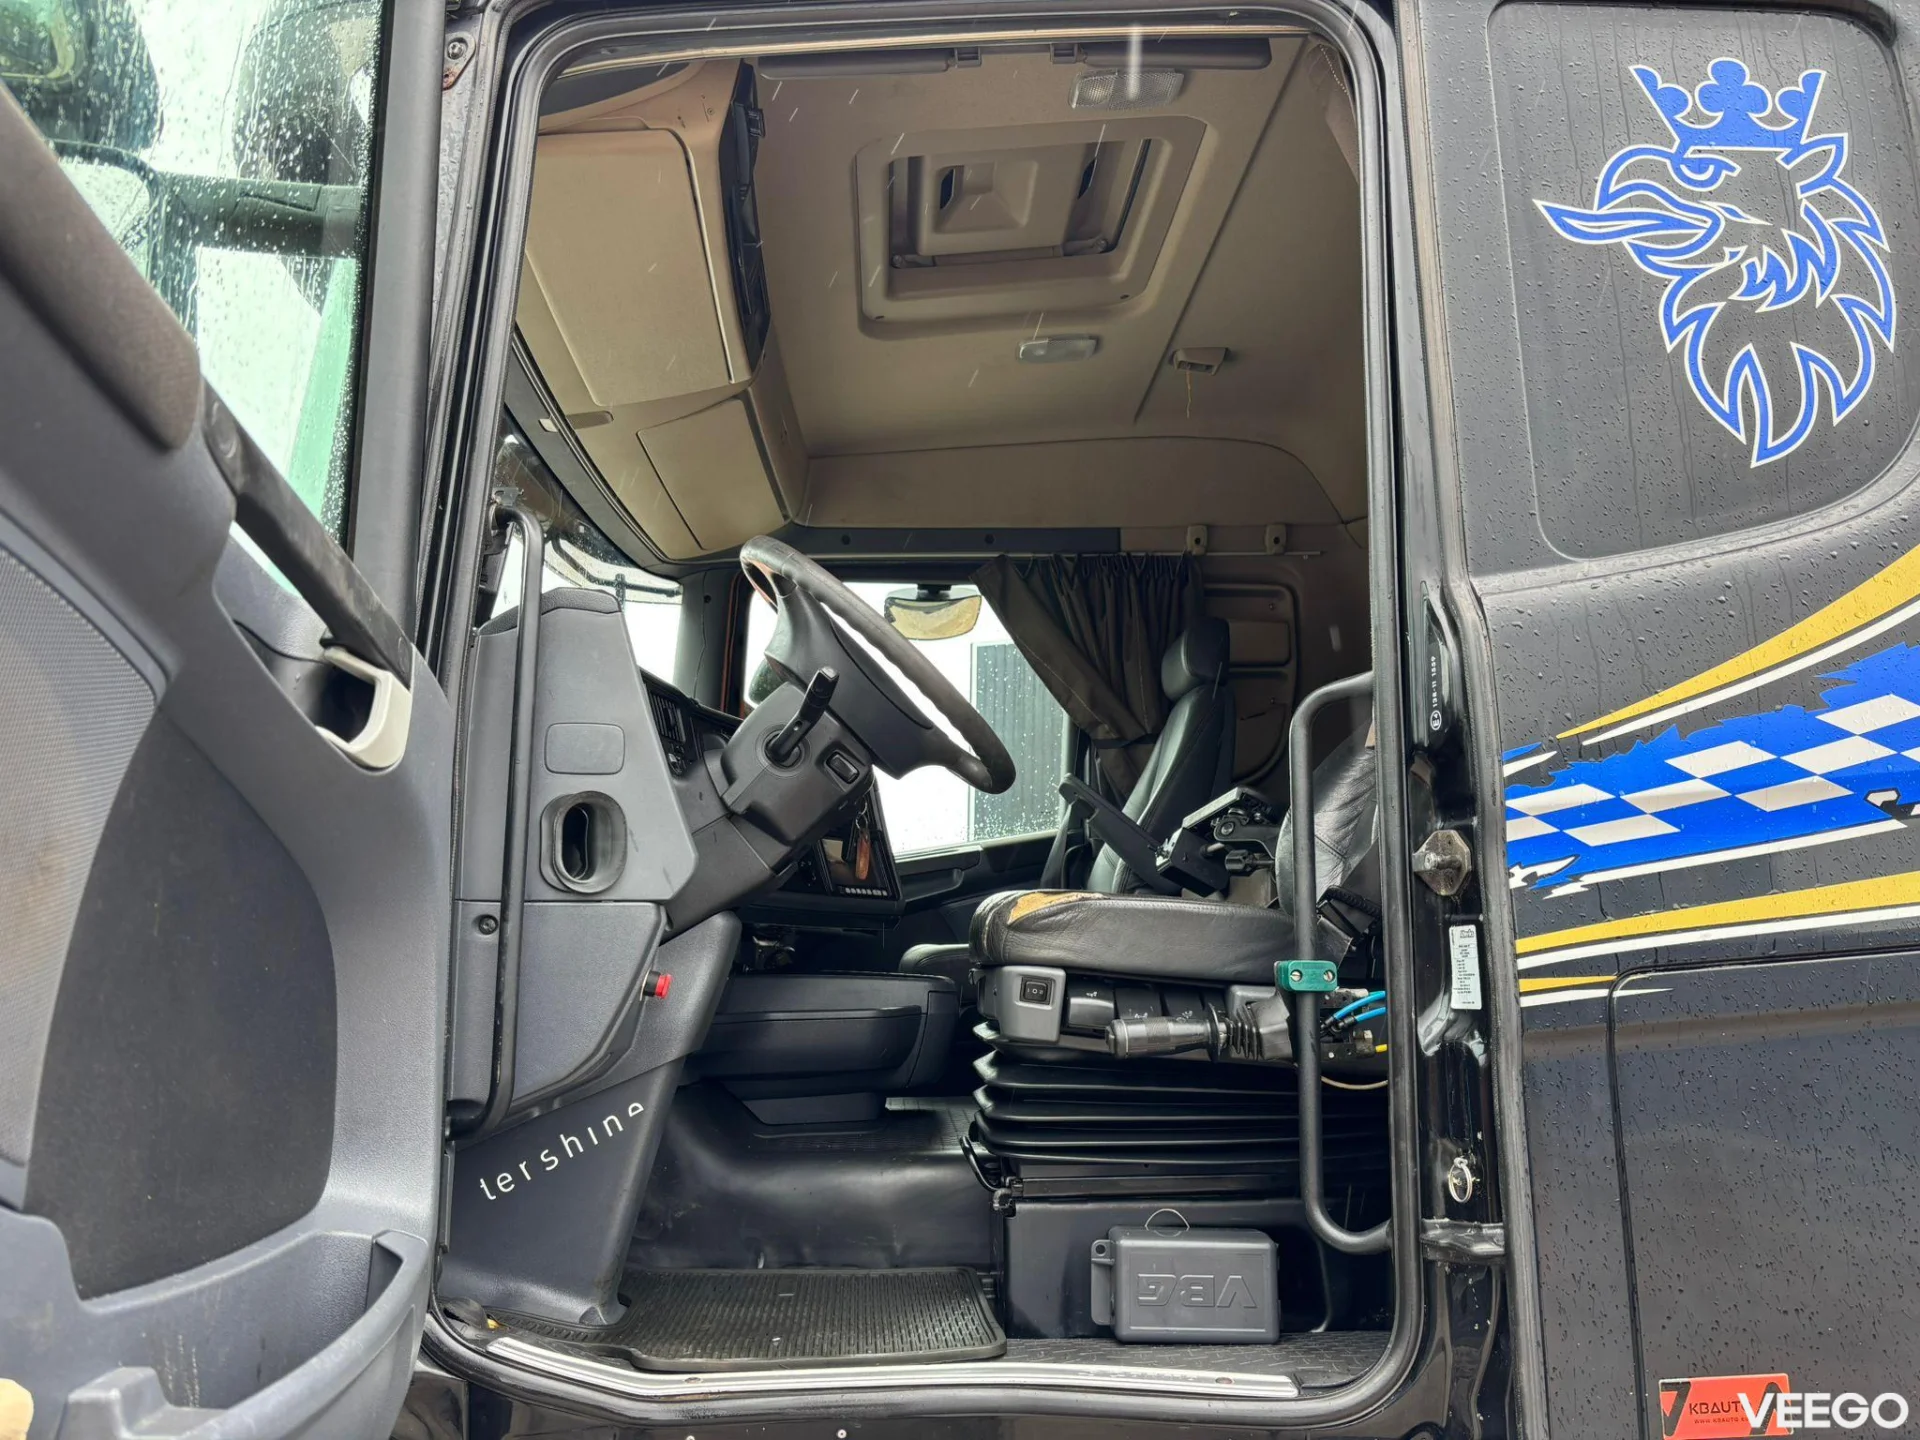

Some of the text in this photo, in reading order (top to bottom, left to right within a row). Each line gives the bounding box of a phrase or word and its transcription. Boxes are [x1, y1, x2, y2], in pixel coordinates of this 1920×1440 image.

[479, 1102, 644, 1200] tershine
[1137, 1273, 1258, 1309] VBG
[1689, 1400, 1745, 1415] KBAUT
